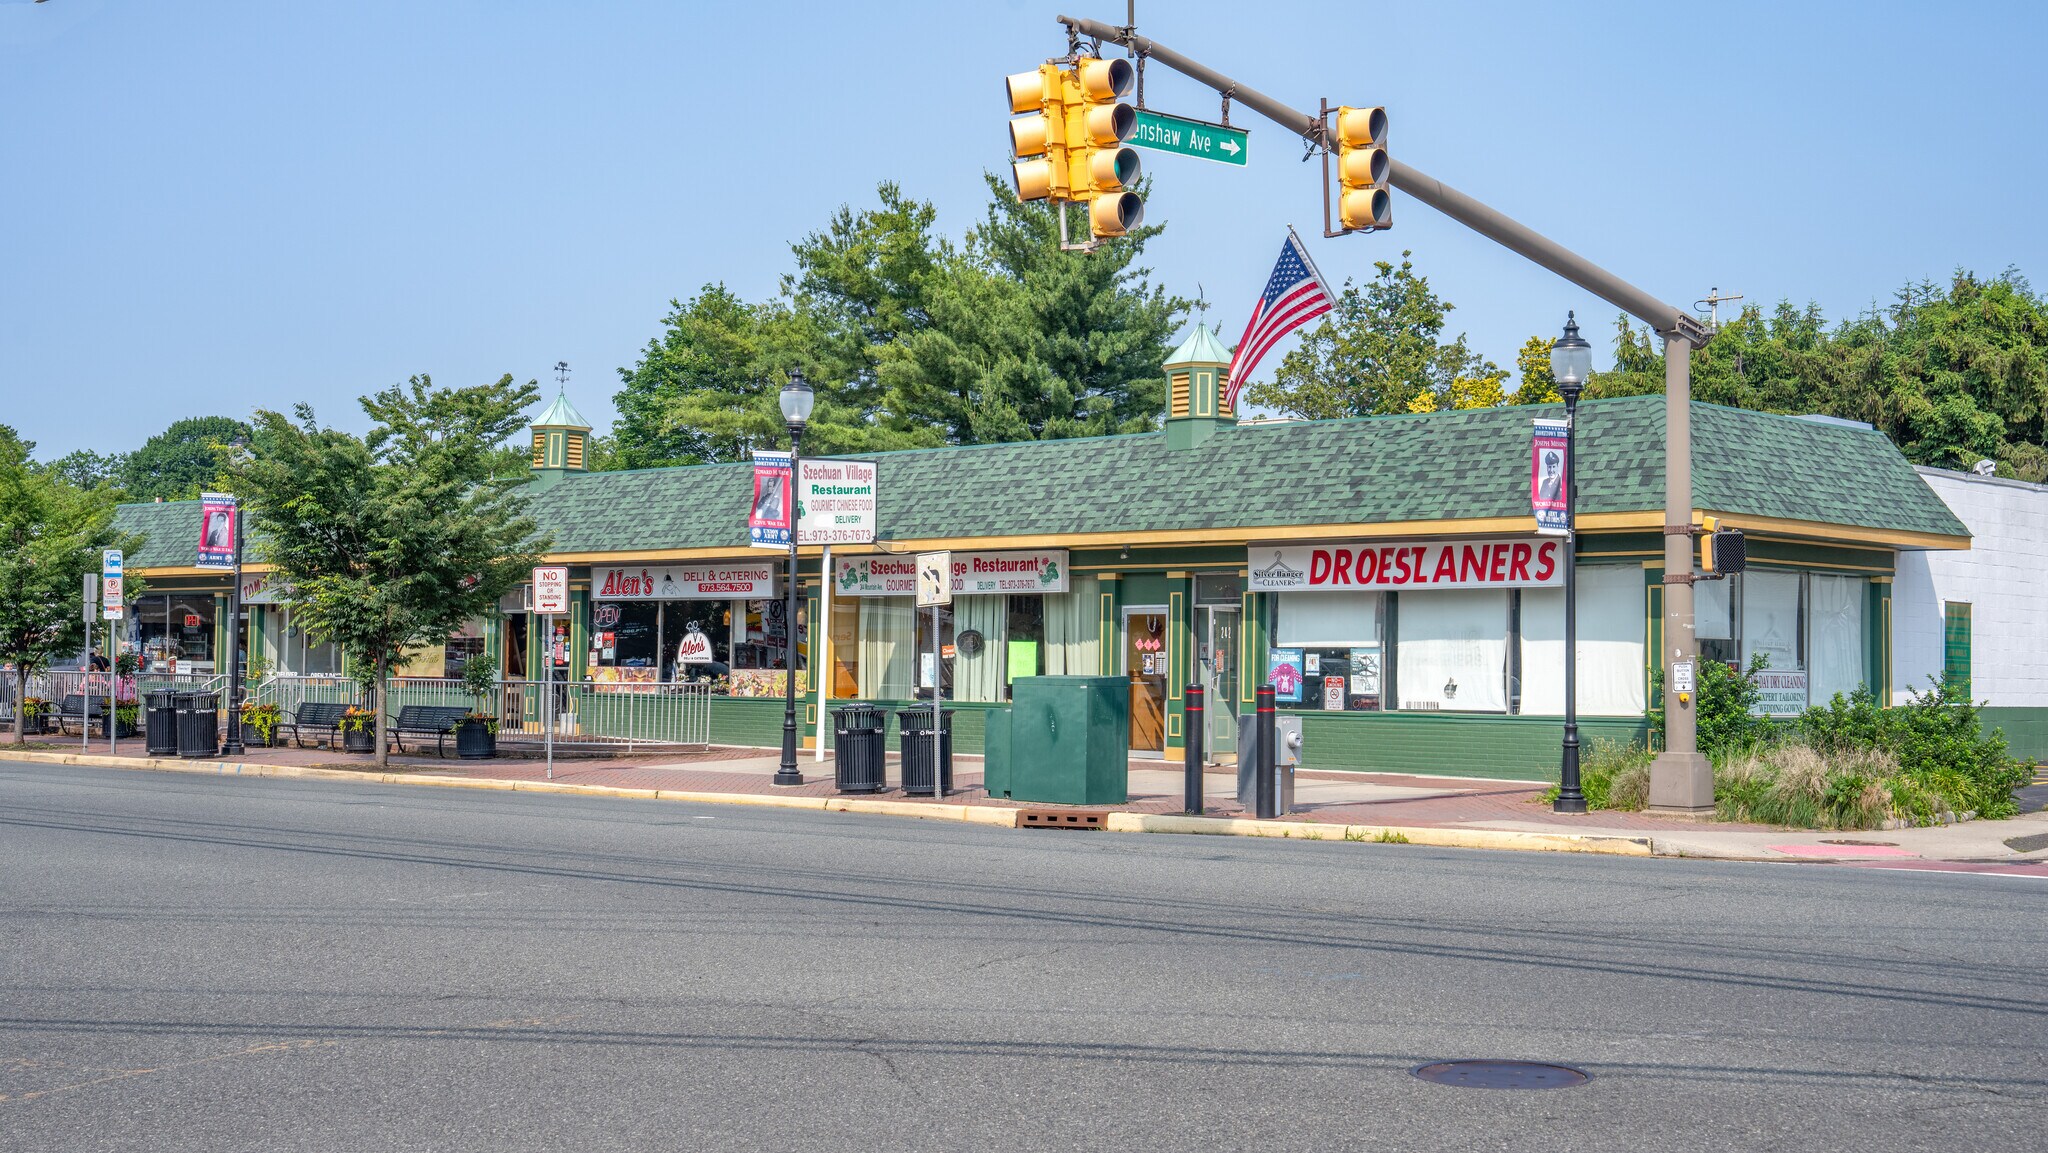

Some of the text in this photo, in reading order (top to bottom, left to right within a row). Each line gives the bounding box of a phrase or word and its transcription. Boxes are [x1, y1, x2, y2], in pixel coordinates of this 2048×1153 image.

[1134, 123, 1211, 152] enshaw Ave
[803, 464, 873, 483] Szechuan Village
[812, 484, 871, 495] Restaurant
[811, 499, 873, 511] GOURMET CHINESE FOOD
[835, 515, 862, 524] DELIVERY
[797, 529, 871, 541] EL:973-376-7673
[871, 560, 916, 575] Szechua
[973, 557, 1038, 573] Restaurant
[543, 572, 557, 580] NO
[1253, 570, 1304, 579] Silver Hanger
[601, 569, 768, 597] Alen's DELI & CATERING
[700, 583, 750, 592] 973.564.7500
[886, 579, 916, 591] GOURMET
[977, 581, 996, 590] DELIVERY
[1262, 579, 1296, 587] CLEANERS
[594, 608, 619, 623] OPEN
[1221, 626, 1231, 639] 242
[681, 637, 705, 657] Alen's
[1271, 654, 1300, 663] FOR CLEANING
[1759, 676, 1769, 688] DAY
[1770, 676, 1780, 688] DRY
[1781, 676, 1806, 688] CLEANING
[1759, 692, 1805, 702] EXPERT TAILORING
[1759, 704, 1803, 713] WEDDING GOWNS
